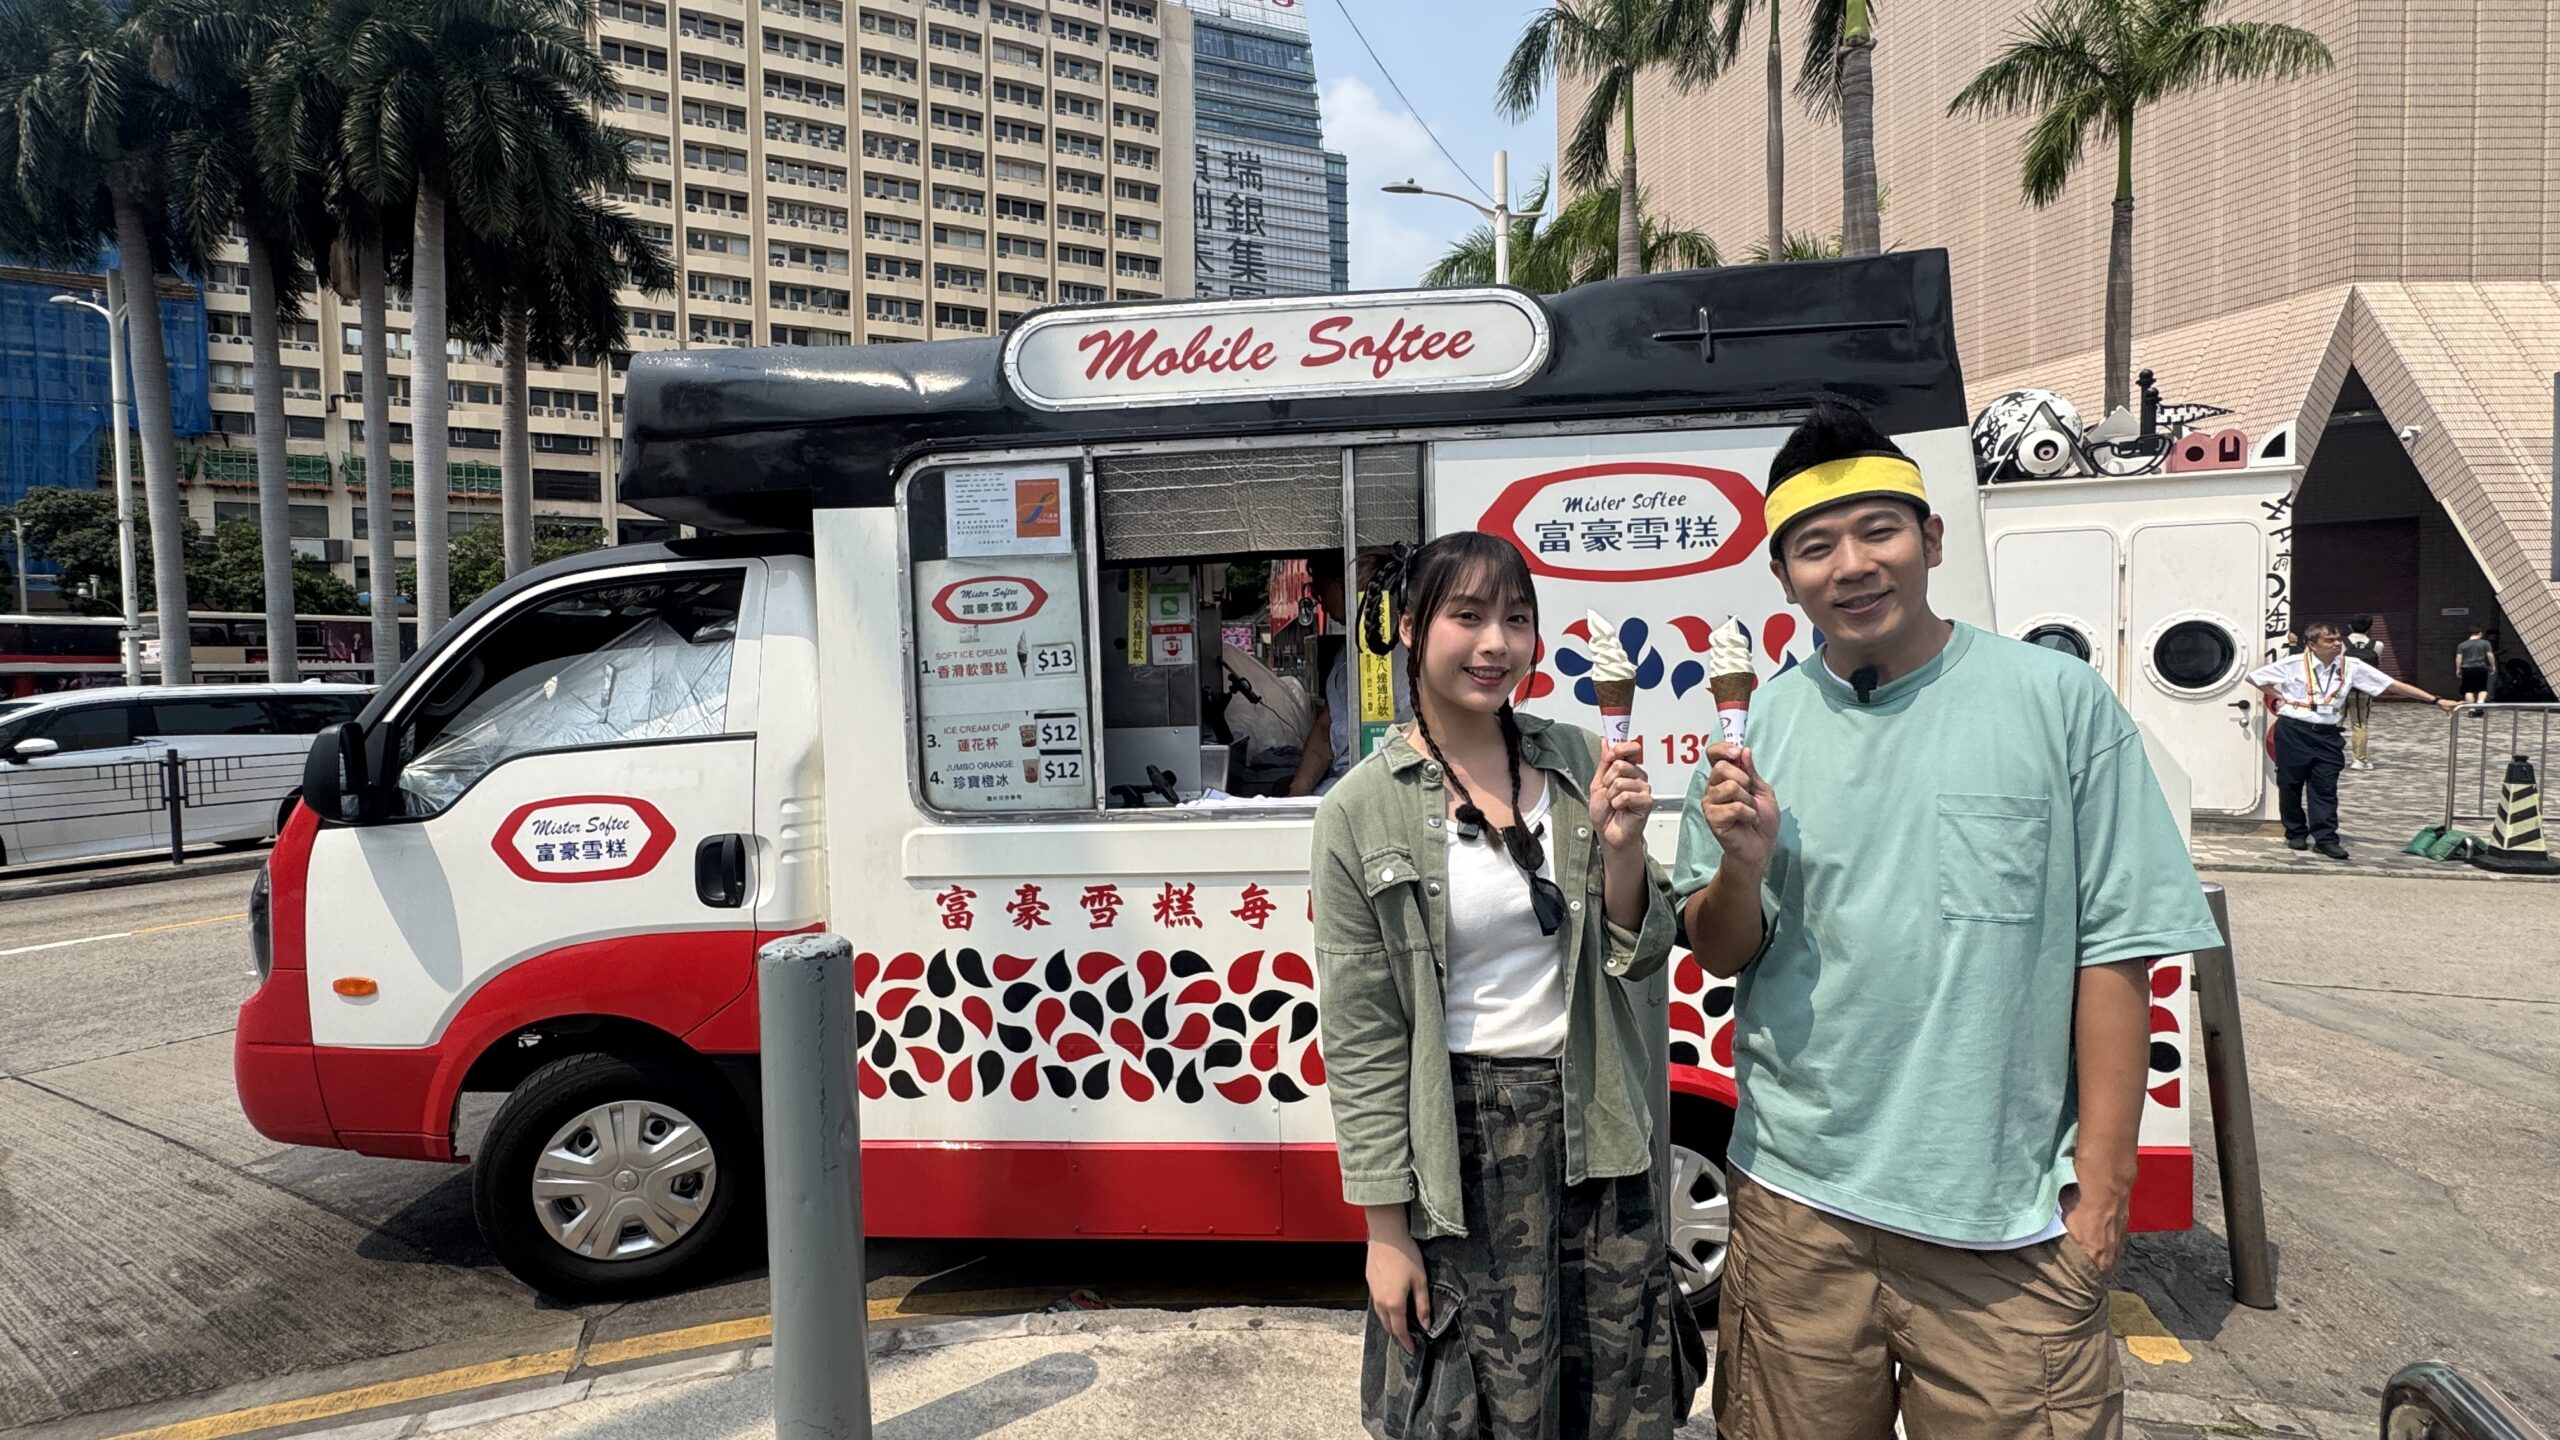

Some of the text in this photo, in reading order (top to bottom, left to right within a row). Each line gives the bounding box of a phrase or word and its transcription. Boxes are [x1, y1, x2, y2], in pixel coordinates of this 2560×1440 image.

[1078, 315, 1475, 382] Mobile Softee
[1562, 491, 1687, 514] Mister Softee
[1535, 514, 1720, 554] 富豪雪糕
[960, 587, 1018, 599] Mister Softee
[962, 600, 1018, 615] 富豪雪糕
[935, 648, 1008, 661] SOFT ICE CREAM
[1038, 649, 1073, 671] $13
[921, 660, 1008, 679] 1. 香滑軟雪糕
[943, 723, 1010, 735] ICE CREAM CUP
[1042, 723, 1077, 744] $12
[927, 735, 999, 752] 3. 蓮花杯
[1660, 734, 1710, 765] 13
[945, 760, 1014, 772] JUMBO ORANGE
[1045, 760, 1080, 782] $12
[929, 771, 1009, 790] 4. 珍寶橙冰
[532, 815, 630, 836] Mister Softee
[535, 838, 628, 862] 富豪雪糕
[936, 882, 1313, 931] 富豪雪糕每
